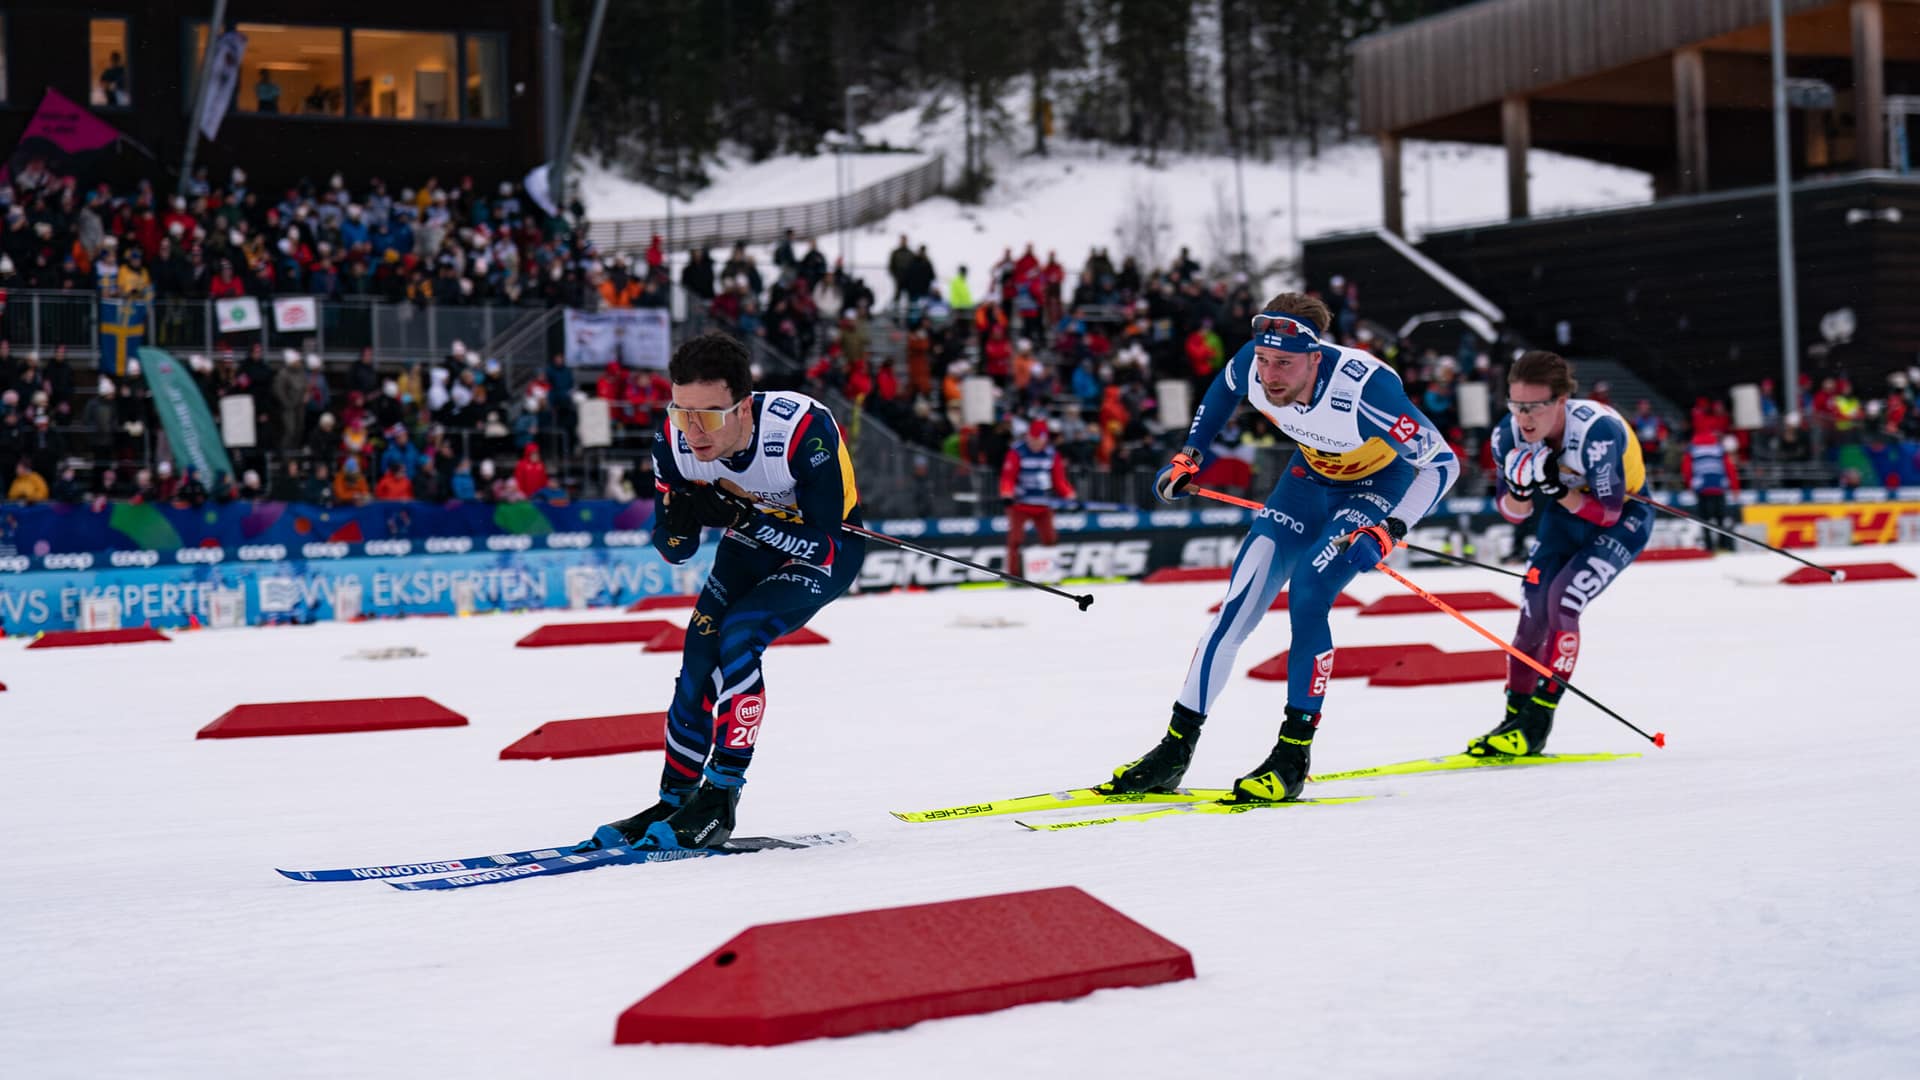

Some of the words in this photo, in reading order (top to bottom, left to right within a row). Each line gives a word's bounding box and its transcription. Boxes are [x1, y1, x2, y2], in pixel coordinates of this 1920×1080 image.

[1331, 400, 1351, 410] coop
[1394, 417, 1415, 440] IS
[1594, 534, 1632, 566] STIFE
[860, 540, 1151, 588] SKECERS
[757, 573, 813, 587] RAFT
[1560, 556, 1617, 613] USA
[0, 588, 49, 624] VS
[61, 580, 246, 622] ESPERTE
[1553, 655, 1575, 673] 46
[1313, 676, 1327, 695] 5
[741, 704, 761, 717] RIIS
[731, 725, 758, 746] 20
[924, 803, 994, 820] FISCHER
[351, 860, 451, 879] SALOMON
[446, 866, 532, 887] SALOMON
